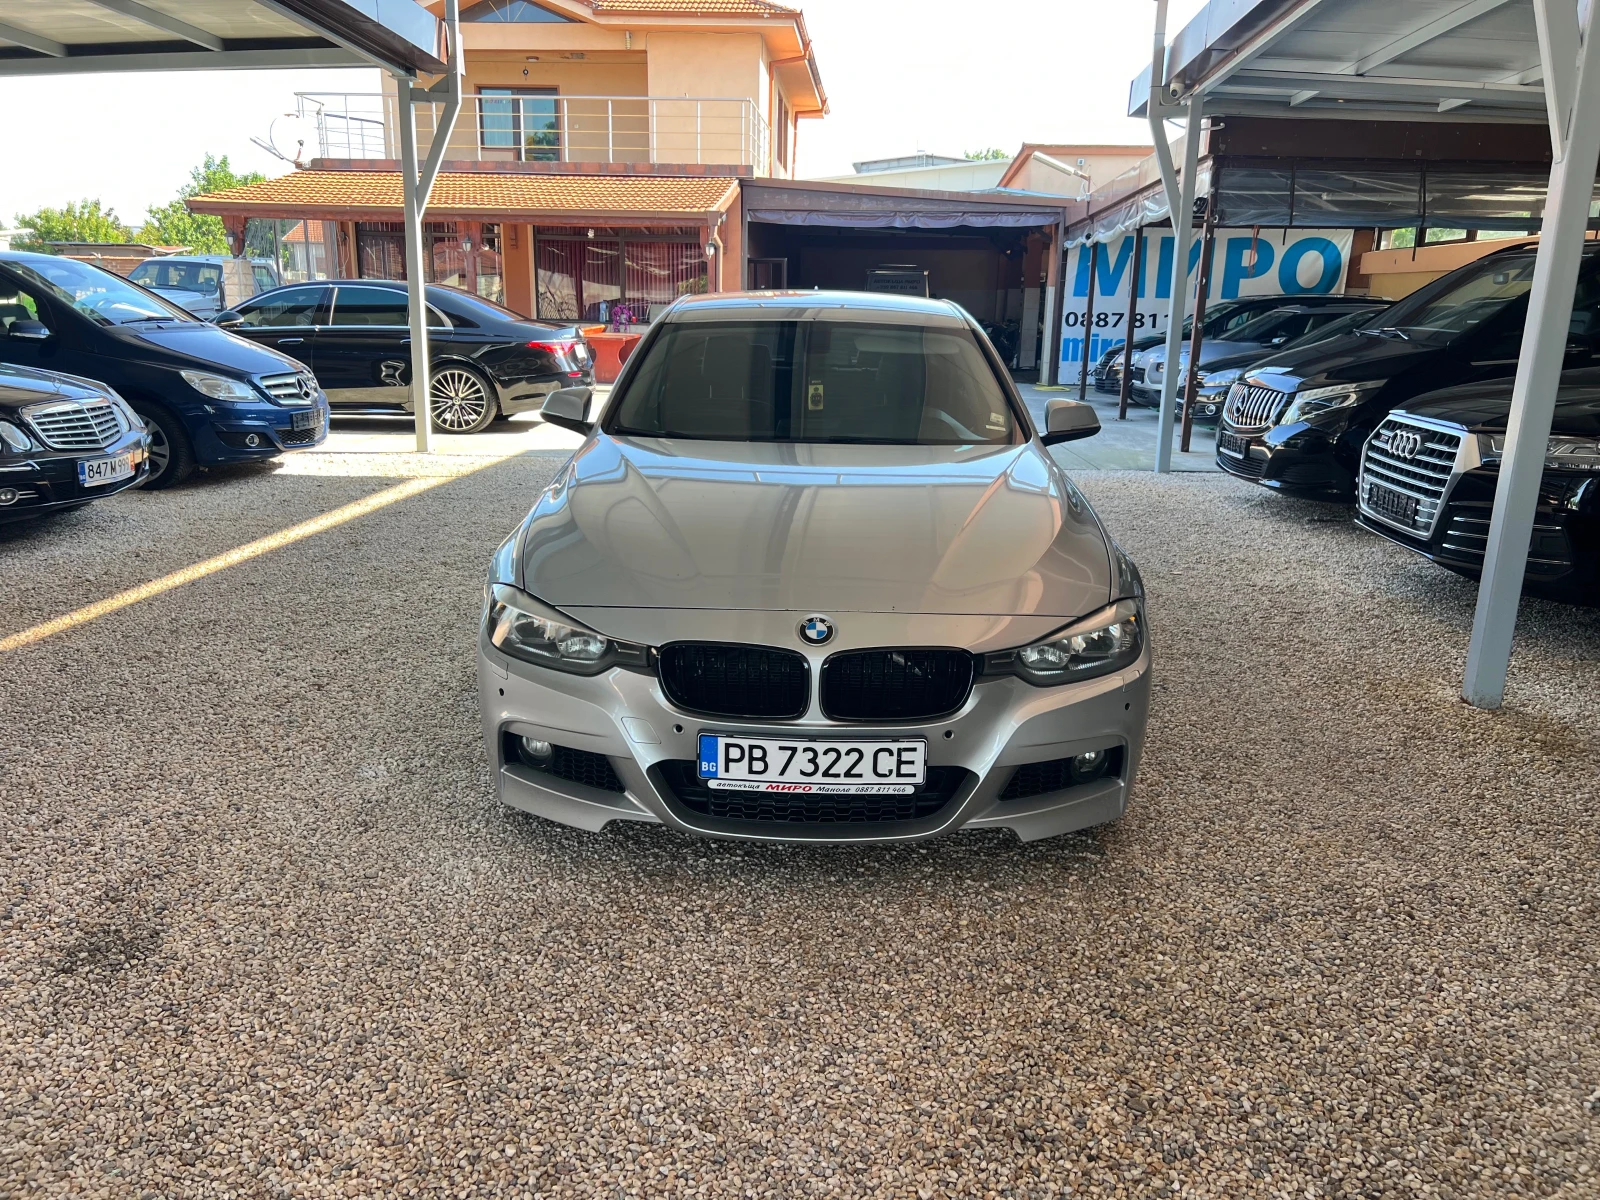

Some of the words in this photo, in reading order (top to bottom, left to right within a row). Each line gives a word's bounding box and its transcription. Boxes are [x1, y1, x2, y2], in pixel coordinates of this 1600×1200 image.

[1072, 236, 1342, 299] МИРО
[1065, 312, 1125, 328] 0887
[1062, 333, 1126, 362] mir
[88, 462, 108, 479] 847
[110, 460, 117, 475] M
[118, 456, 129, 473] 999
[802, 617, 832, 627] BMW
[701, 761, 716, 772] BG
[724, 743, 769, 775] PB
[778, 746, 864, 778] 7322
[872, 747, 917, 778] CE
[765, 784, 812, 792] МИРО
